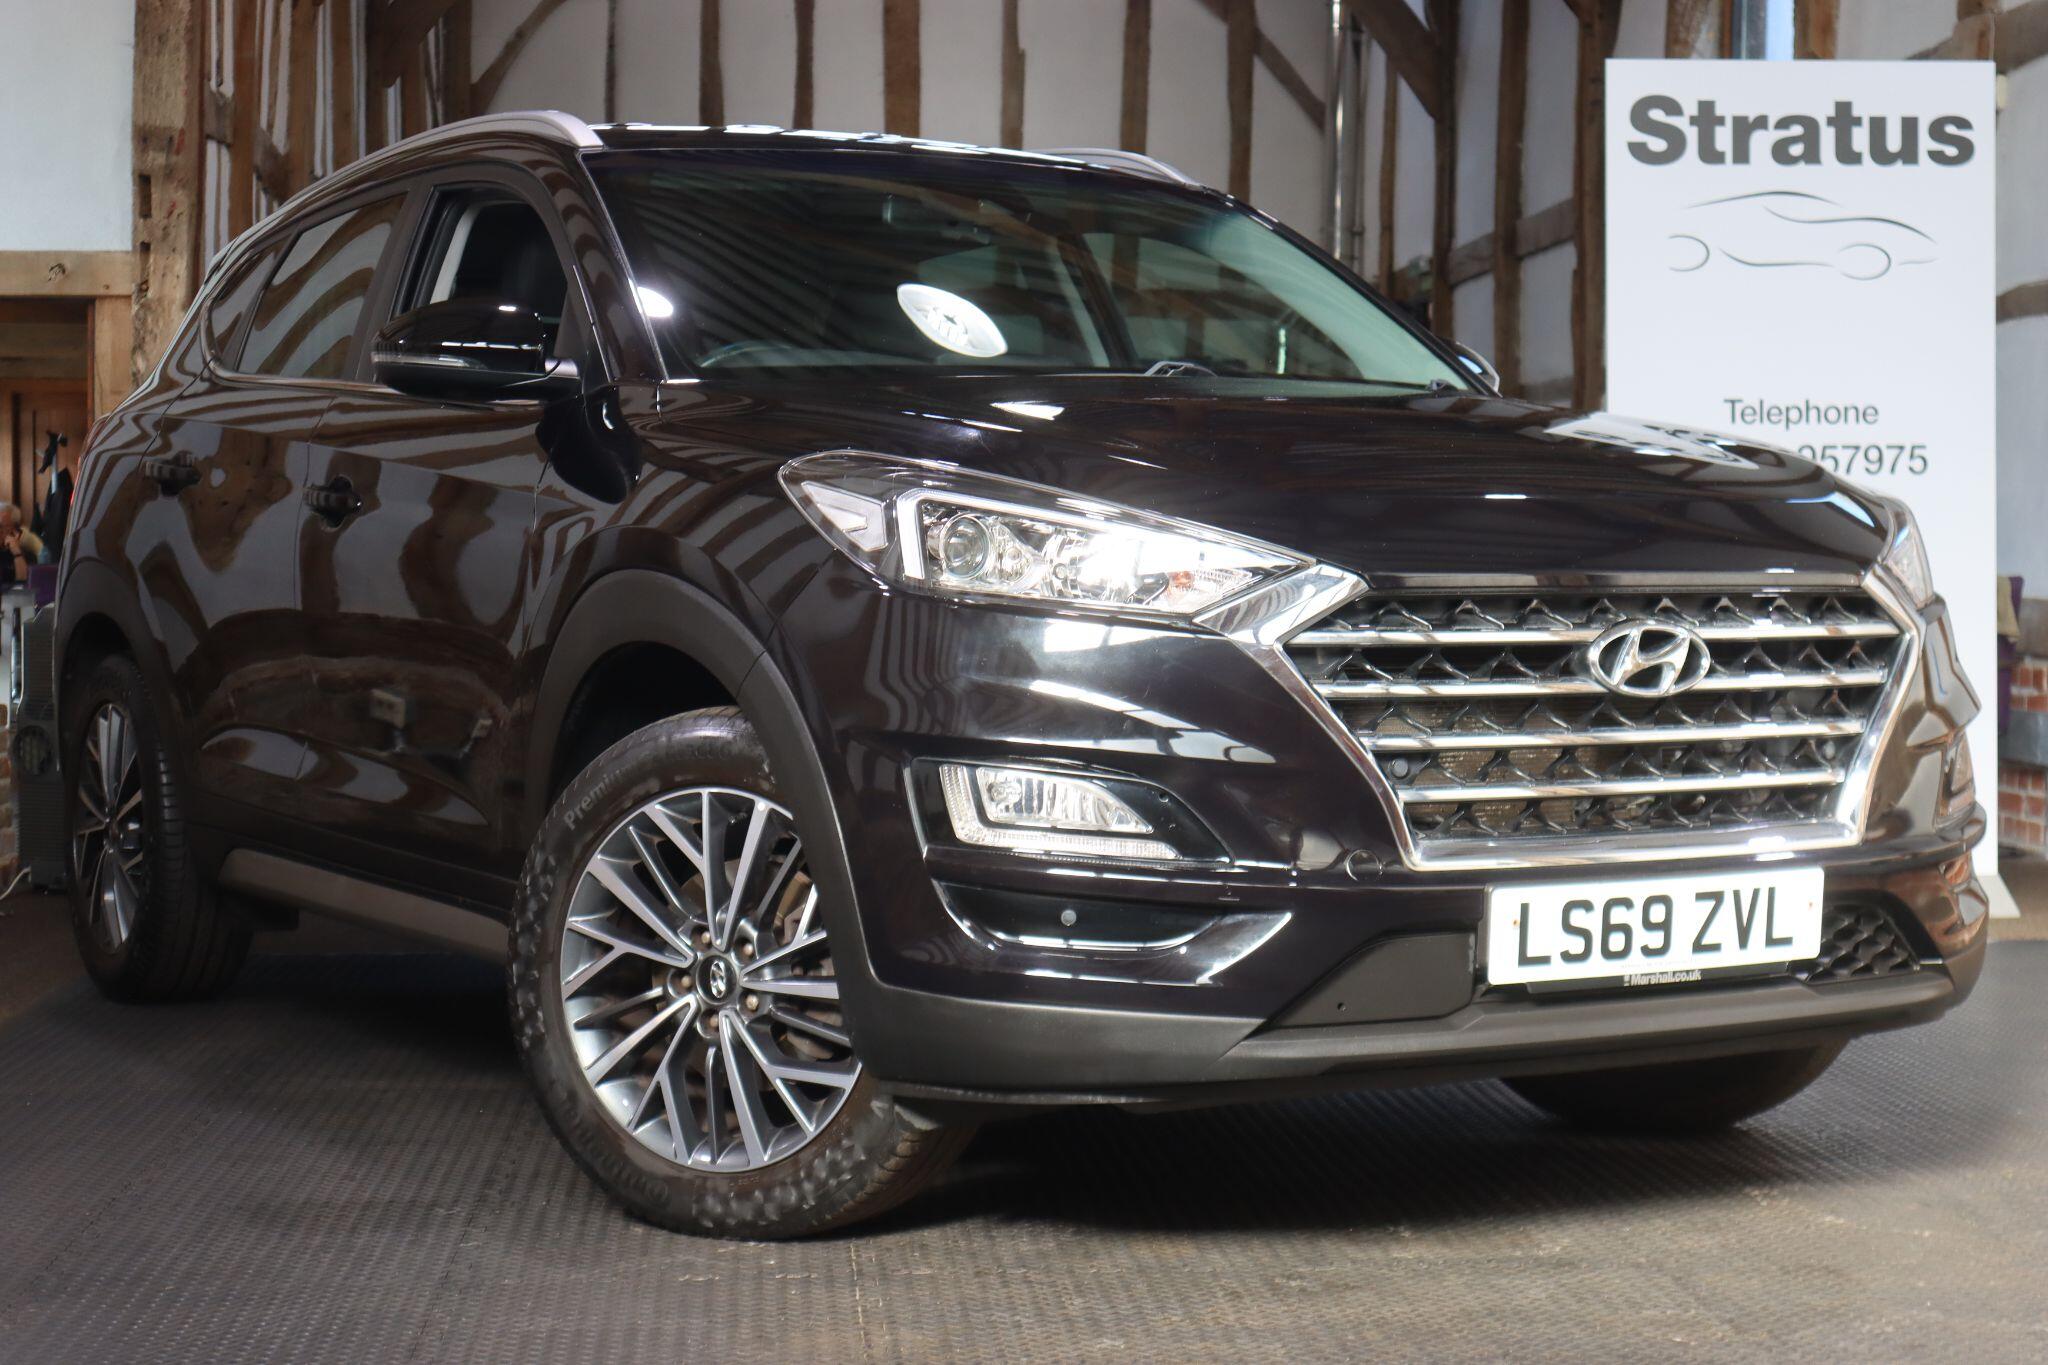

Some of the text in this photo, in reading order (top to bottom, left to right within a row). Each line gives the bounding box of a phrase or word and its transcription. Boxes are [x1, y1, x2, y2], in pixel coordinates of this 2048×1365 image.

[1627, 94, 1976, 166] Stratus
[1723, 399, 1880, 431] Telephone
[1517, 886, 1794, 968] LS69 ZVL
[1631, 969, 1702, 986] Marshall.co.uk
